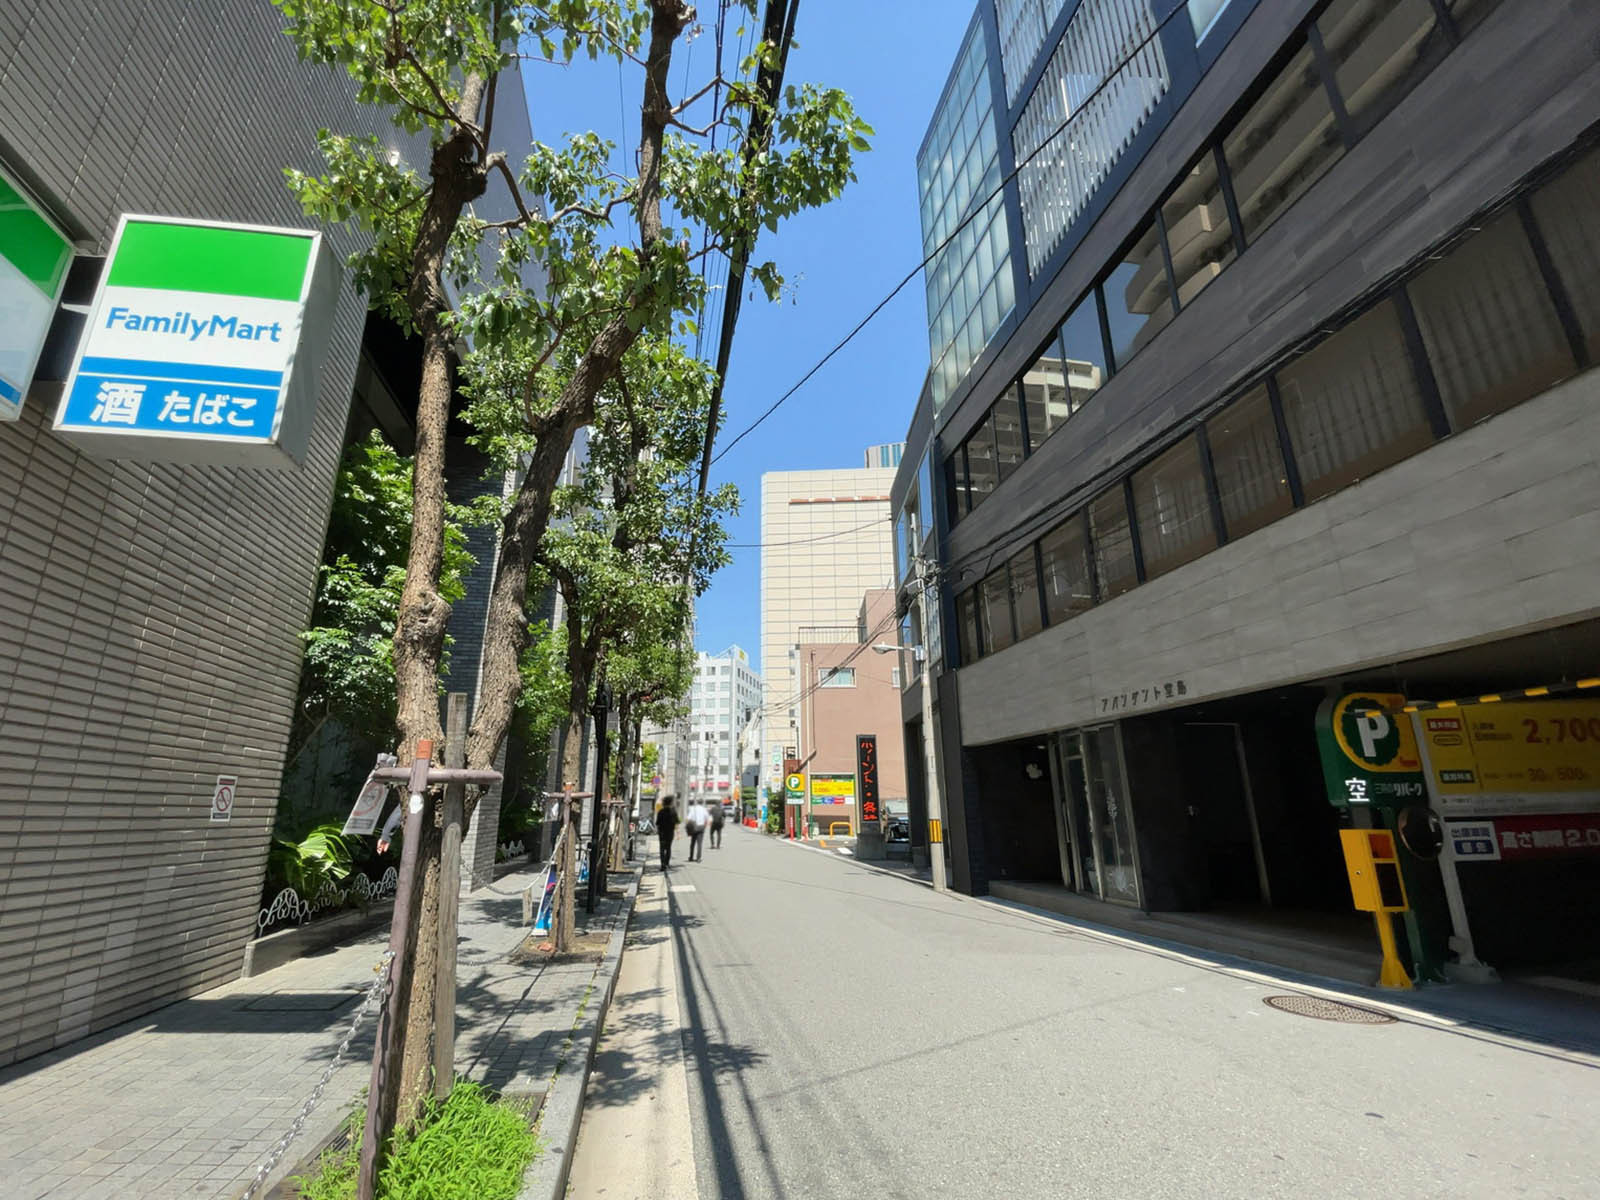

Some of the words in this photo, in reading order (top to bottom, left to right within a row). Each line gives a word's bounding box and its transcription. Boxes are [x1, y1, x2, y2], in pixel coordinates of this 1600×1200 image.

[105, 307, 282, 342] FamilyMart
[90, 381, 147, 426] 酒
[158, 390, 258, 428] たばこ
[1353, 708, 1390, 758] P
[790, 776, 800, 788] P
[1344, 776, 1371, 803] 空
